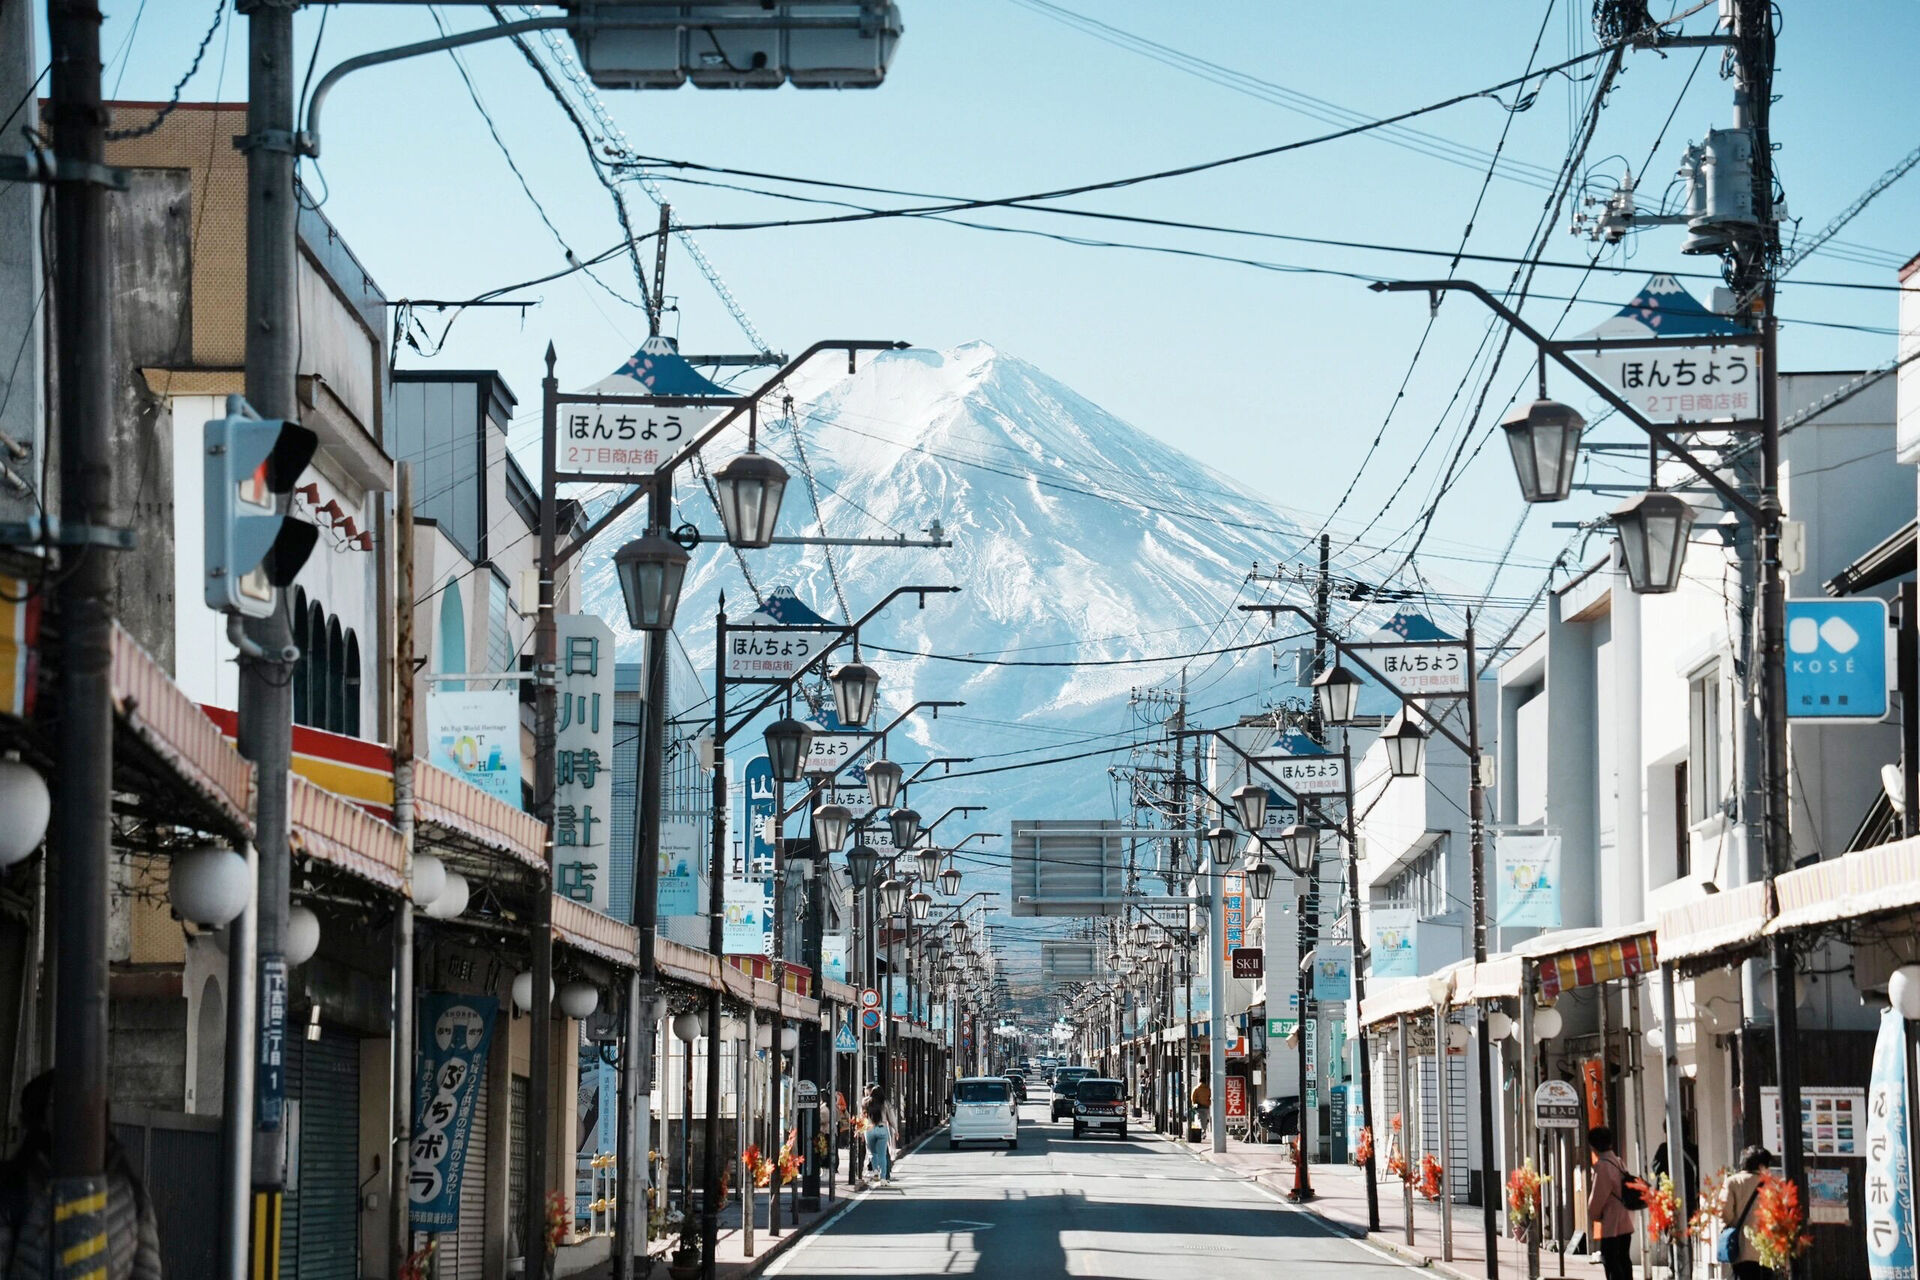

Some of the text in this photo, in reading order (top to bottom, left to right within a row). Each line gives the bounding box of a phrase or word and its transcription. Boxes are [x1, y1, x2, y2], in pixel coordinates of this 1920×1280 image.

[1622, 356, 1748, 388] ほんちょう
[1647, 393, 1749, 412] 2丁目商店街
[569, 414, 683, 442] ほんちょう
[568, 447, 659, 465] 2丁目商店街
[733, 638, 809, 656] ほんちょう
[732, 660, 793, 671] 2丁目商店街
[1384, 653, 1459, 672] ほんちょう
[1793, 656, 1855, 673] KOSÉ
[558, 636, 601, 903] 日川時計店
[1283, 763, 1339, 778] ほんちょう
[865, 994, 876, 1003] 40
[270, 1071, 278, 1090] 1
[1227, 1080, 1242, 1114] 処方せん
[410, 1065, 465, 1197] ぷちボラ
